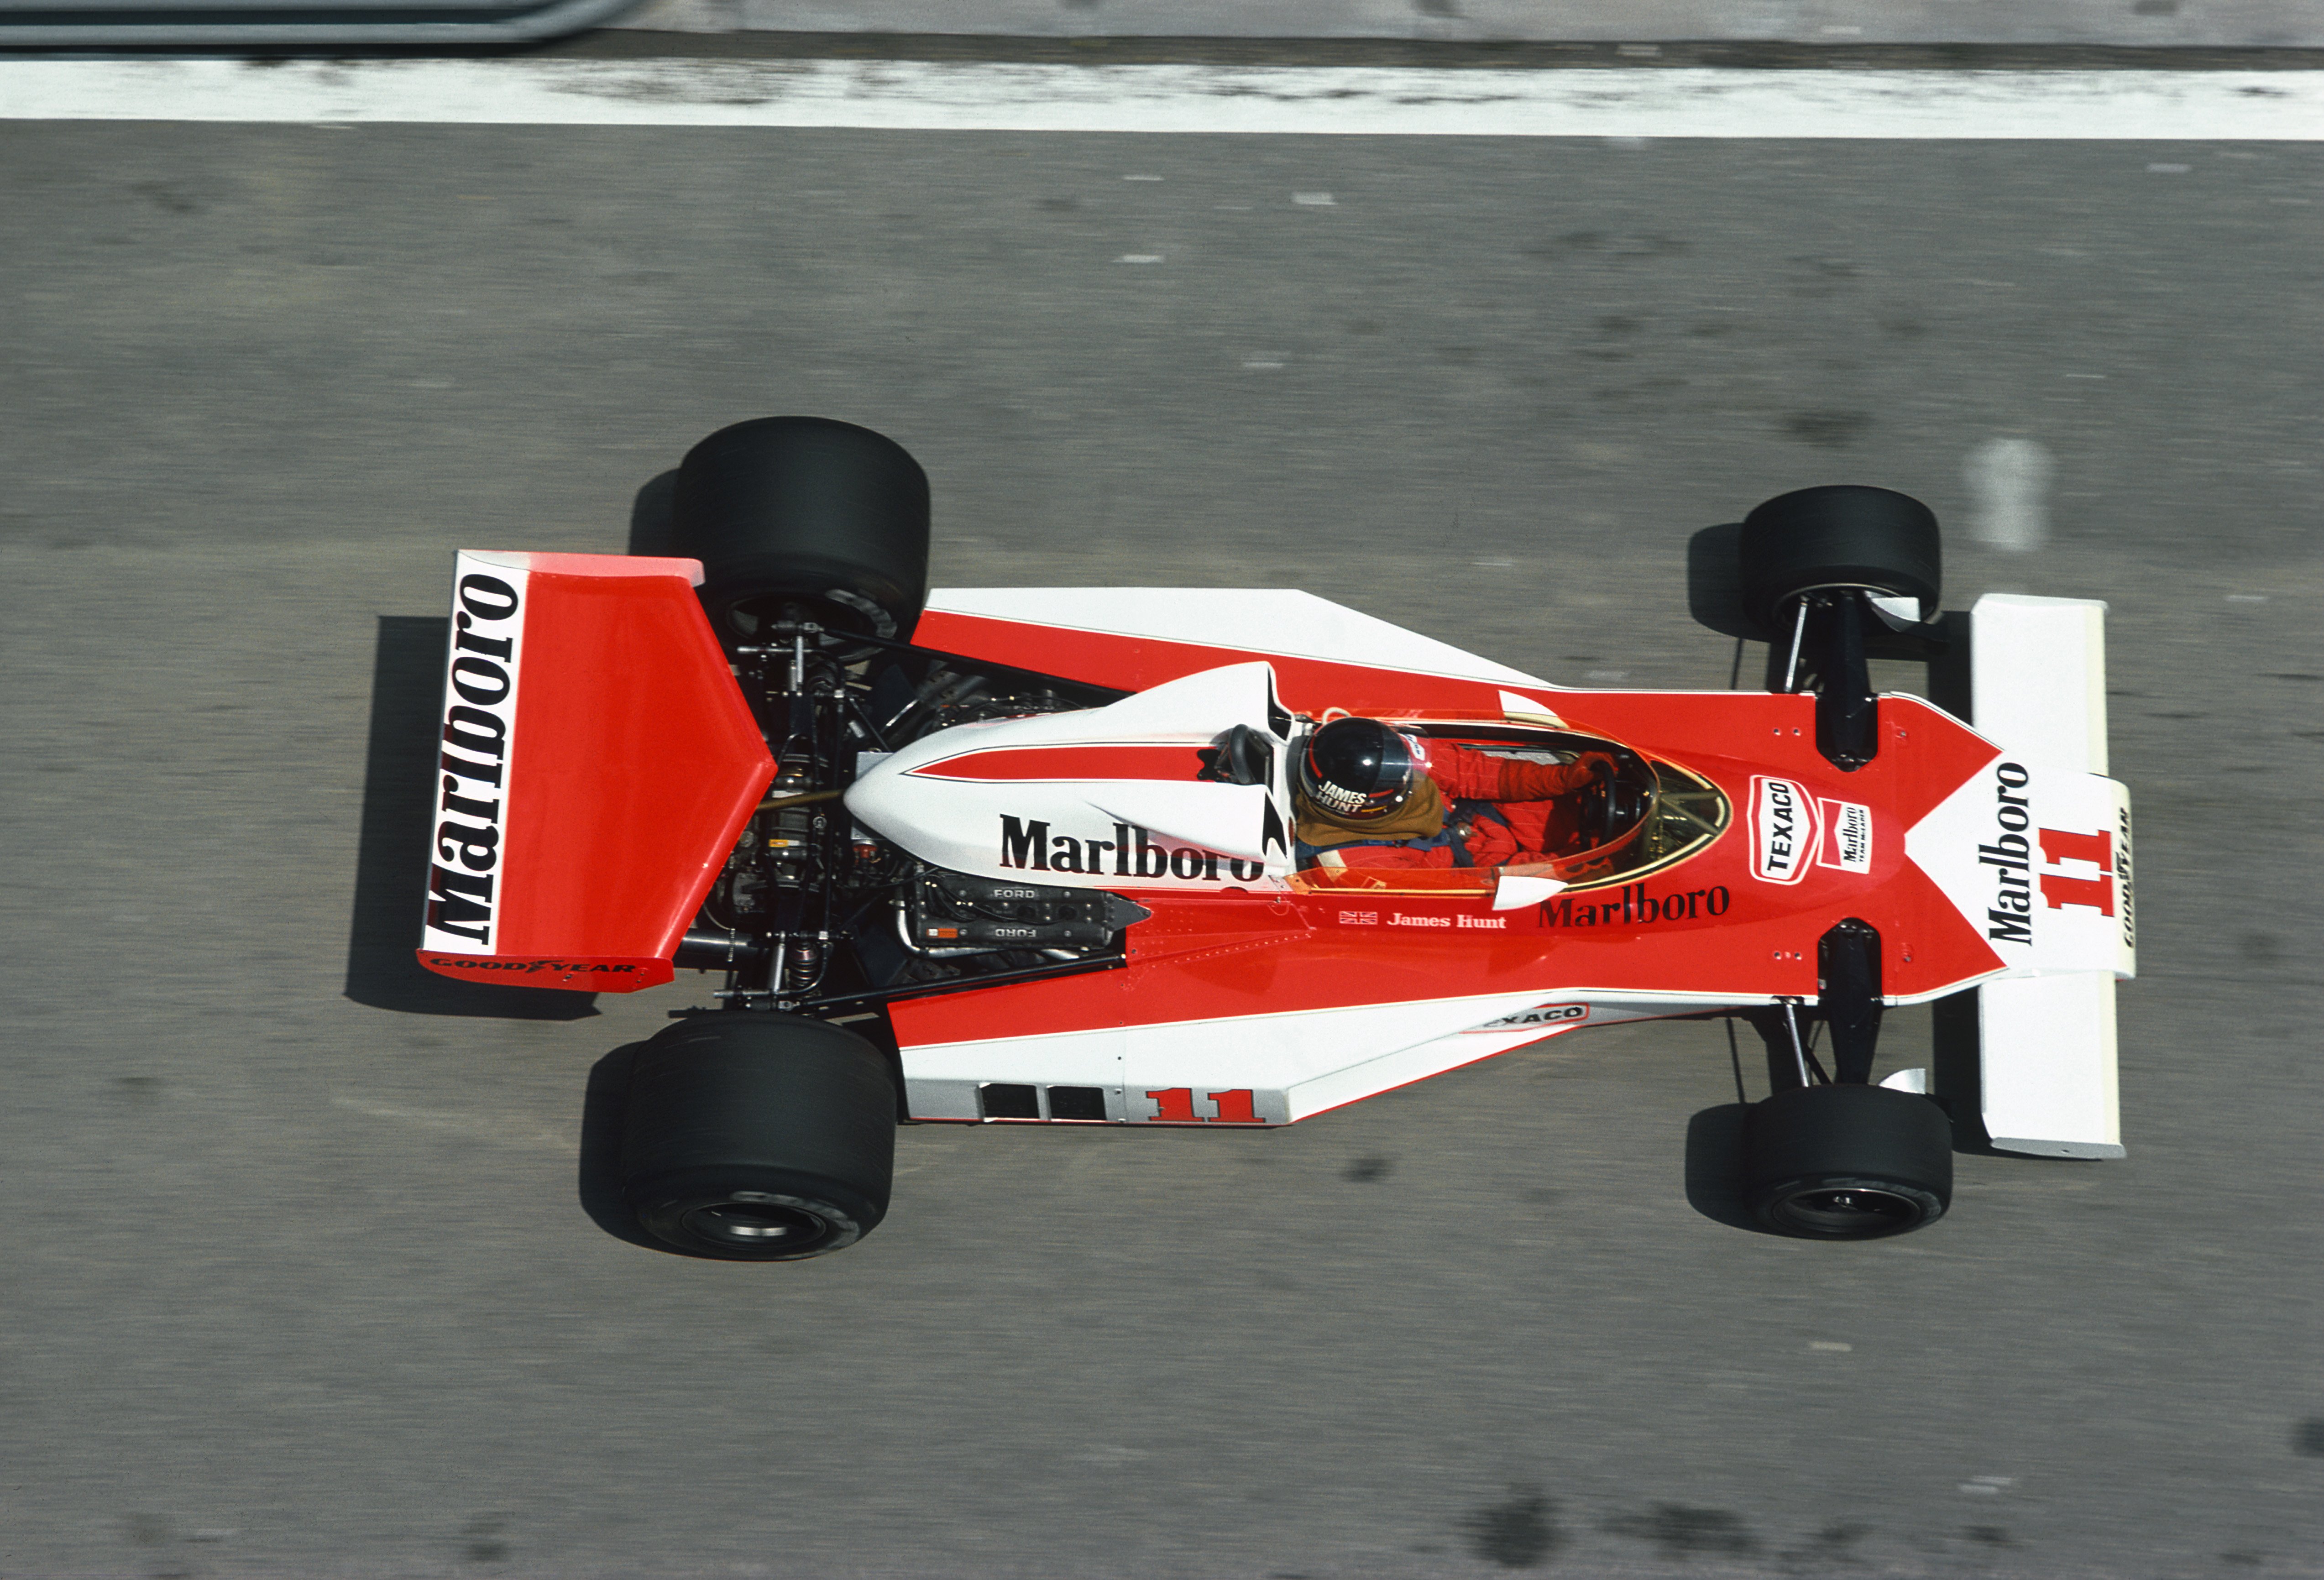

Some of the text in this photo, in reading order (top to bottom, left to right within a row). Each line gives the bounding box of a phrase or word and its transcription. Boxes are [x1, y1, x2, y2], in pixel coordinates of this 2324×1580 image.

[426, 574, 518, 945] Marlboro
[1316, 792, 1362, 812] HUNT
[1318, 780, 1367, 804] JAMES
[1000, 813, 1264, 882] Marlboro
[1767, 782, 1793, 871] TEXACO
[1842, 807, 1858, 862] Marlboro
[1978, 762, 2032, 947] Marlboro
[2038, 827, 2115, 917] 11
[994, 889, 1035, 898] FORD
[1539, 882, 1730, 928] Marlboro
[995, 928, 1036, 937] FORD
[1387, 912, 1507, 929] James Hunt
[1146, 1087, 1266, 1123] 11
